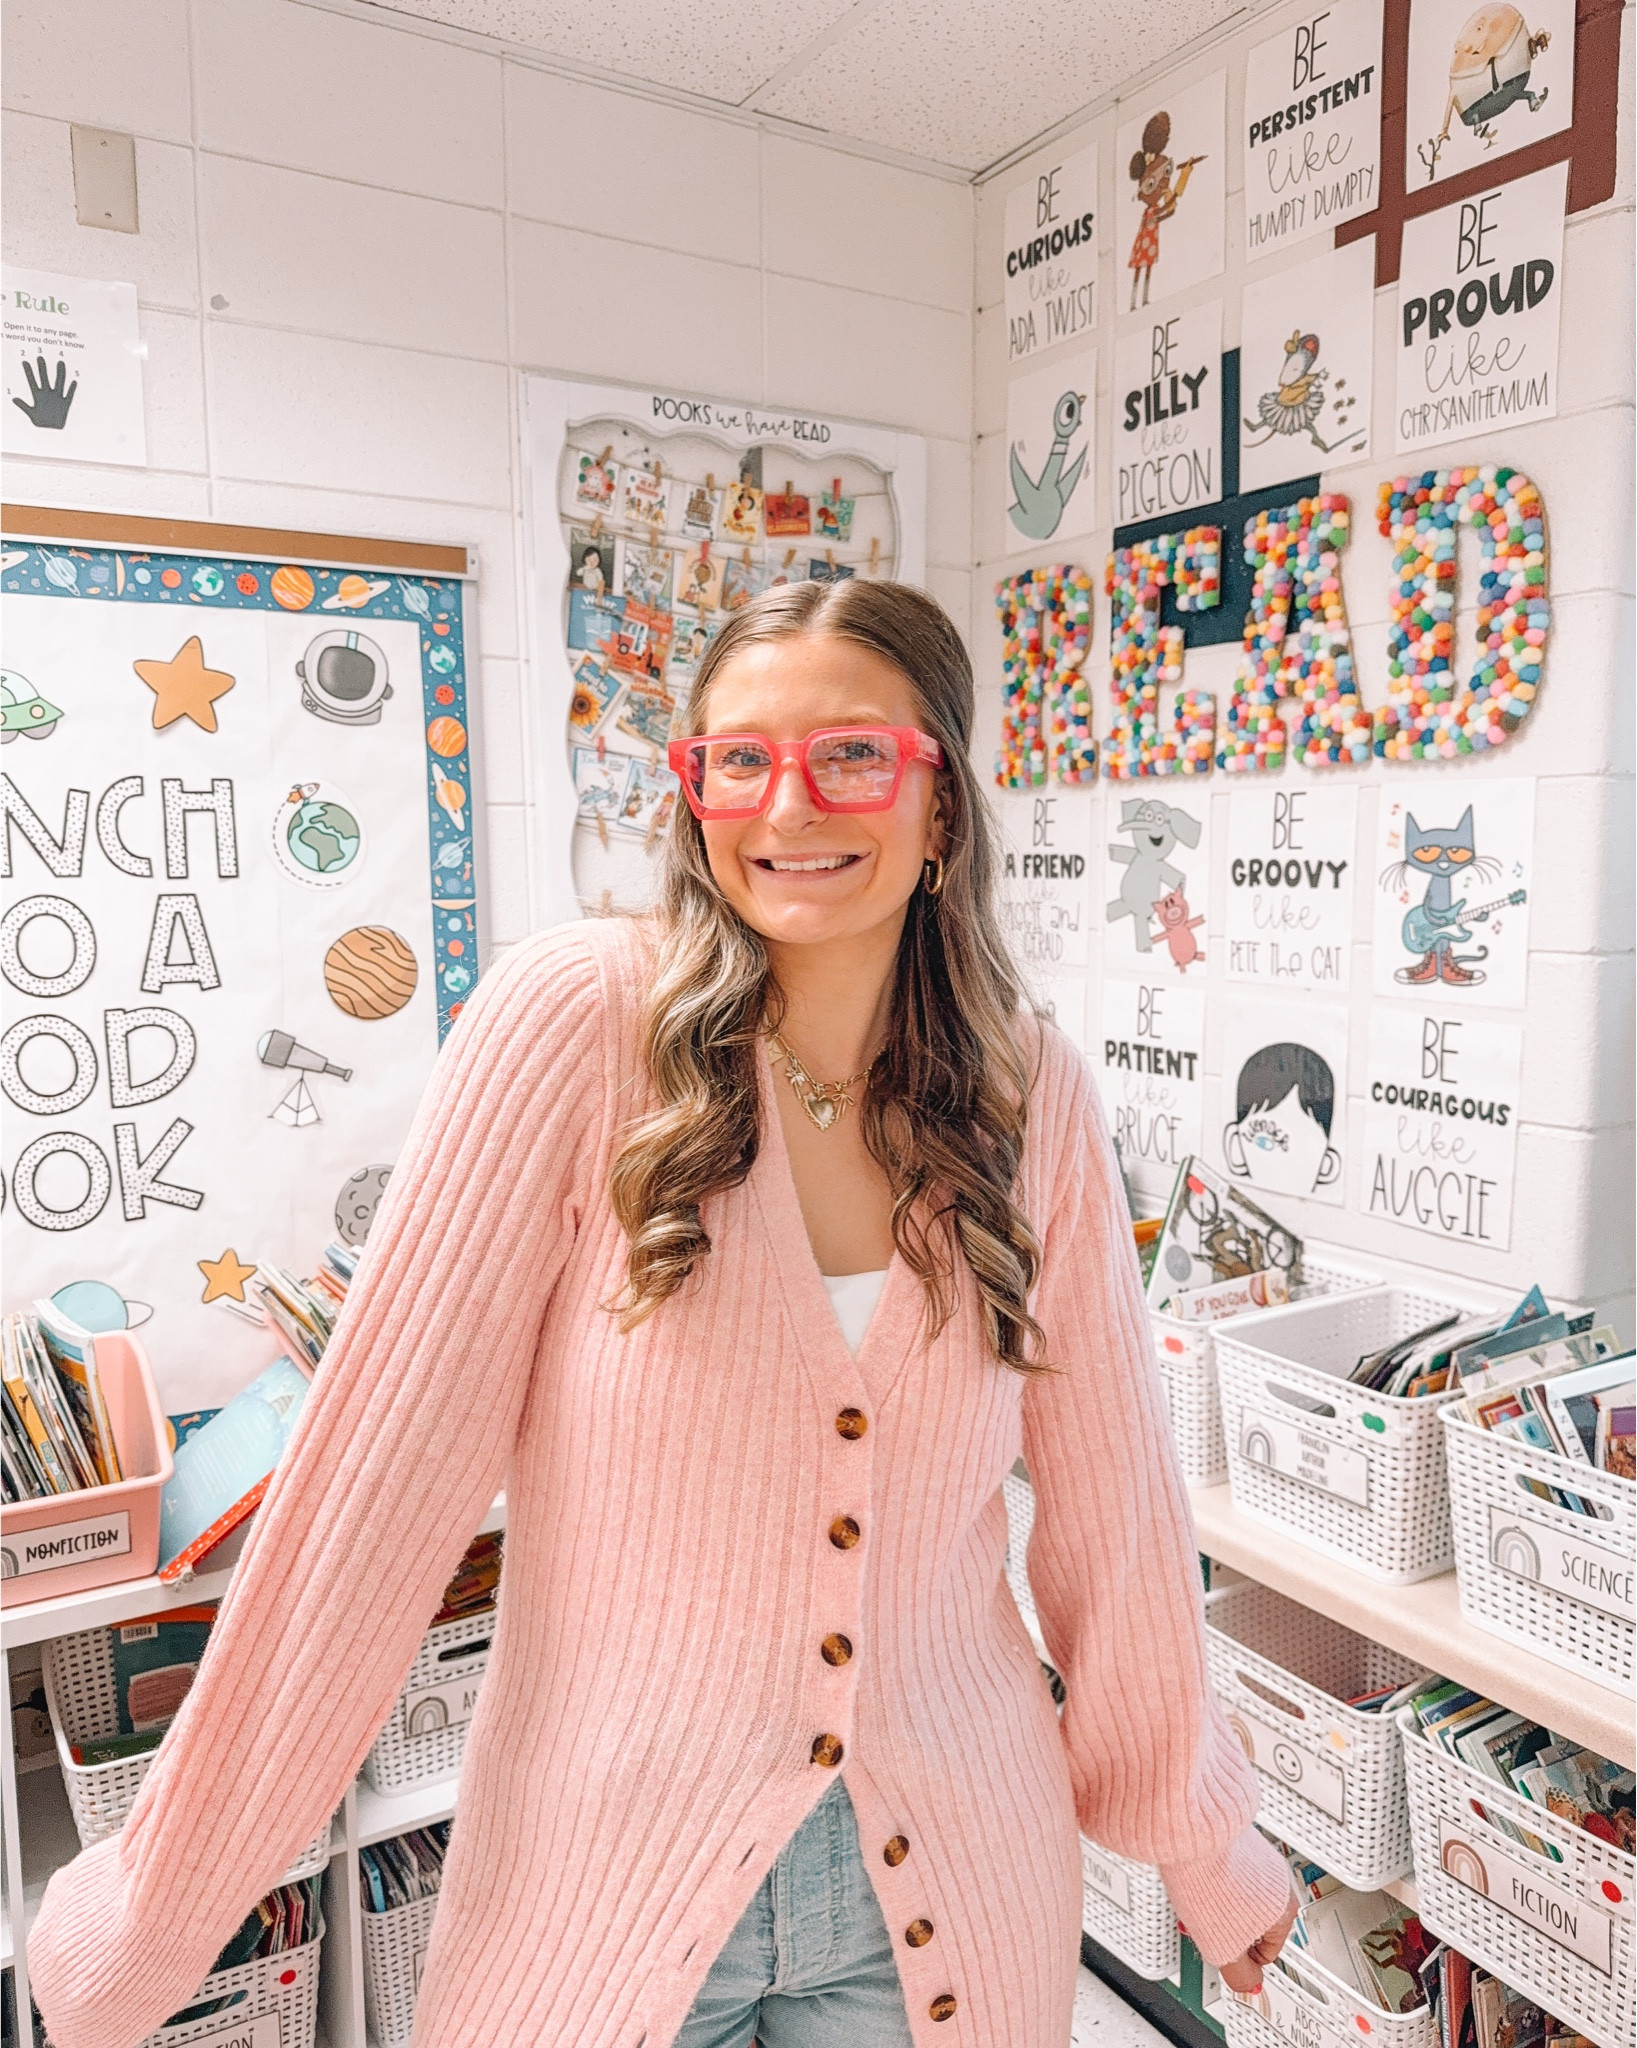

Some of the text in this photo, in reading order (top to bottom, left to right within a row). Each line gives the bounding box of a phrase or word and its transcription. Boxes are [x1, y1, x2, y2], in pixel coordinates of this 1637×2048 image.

[1293, 12, 1330, 90] BE
[1249, 66, 1375, 148] PERSISTENT
[1267, 131, 1353, 194] like
[1036, 166, 1063, 229] BE
[1249, 165, 1375, 248] HUMPTY DUMPTY
[1007, 213, 1094, 278] CURIOUS
[1456, 192, 1502, 274] BE
[14, 291, 70, 316] Rule
[1027, 265, 1070, 302] like
[1403, 259, 1554, 347] PROUD
[4, 321, 25, 331] Open
[44, 328, 57, 336] any
[5, 333, 26, 341] word
[27, 336, 42, 344] you
[1009, 282, 1095, 354] ADA TWIST
[1151, 318, 1181, 382] BE
[1424, 331, 1527, 393] like
[652, 396, 832, 443] BOOKS we have READ
[1124, 366, 1209, 432] SILLY
[1400, 371, 1550, 442] CHRYSANTHEMUM
[1141, 421, 1190, 459] like
[1119, 447, 1212, 523] PIGEON
[995, 465, 1551, 790] READ
[1032, 798, 1057, 847] BE
[1272, 792, 1307, 850] BE
[1005, 853, 1086, 880] A FRIEND
[1231, 857, 1348, 889] GROOVY
[1049, 902, 1081, 932] and
[1252, 893, 1321, 932] like
[140, 893, 222, 994] A
[1231, 940, 1260, 973] PETE
[1311, 946, 1341, 980] CAT
[1137, 985, 1166, 1039] BE
[1104, 1040, 1198, 1082] PATIENT
[1422, 1017, 1463, 1084] BE
[1122, 1072, 1177, 1111] like
[1371, 1081, 1512, 1126] COURAGOUS
[1116, 1106, 1182, 1164] BRUCE
[1396, 1115, 1478, 1164] like
[1369, 1153, 1498, 1241] AUGGIE
[26, 1529, 119, 1562] NONFICTION
[1561, 1550, 1634, 1605] SCIENCE
[1512, 1877, 1578, 1939] FICTION
[1276, 2011, 1285, 2028] &
[1295, 2006, 1322, 2041] ABCS
